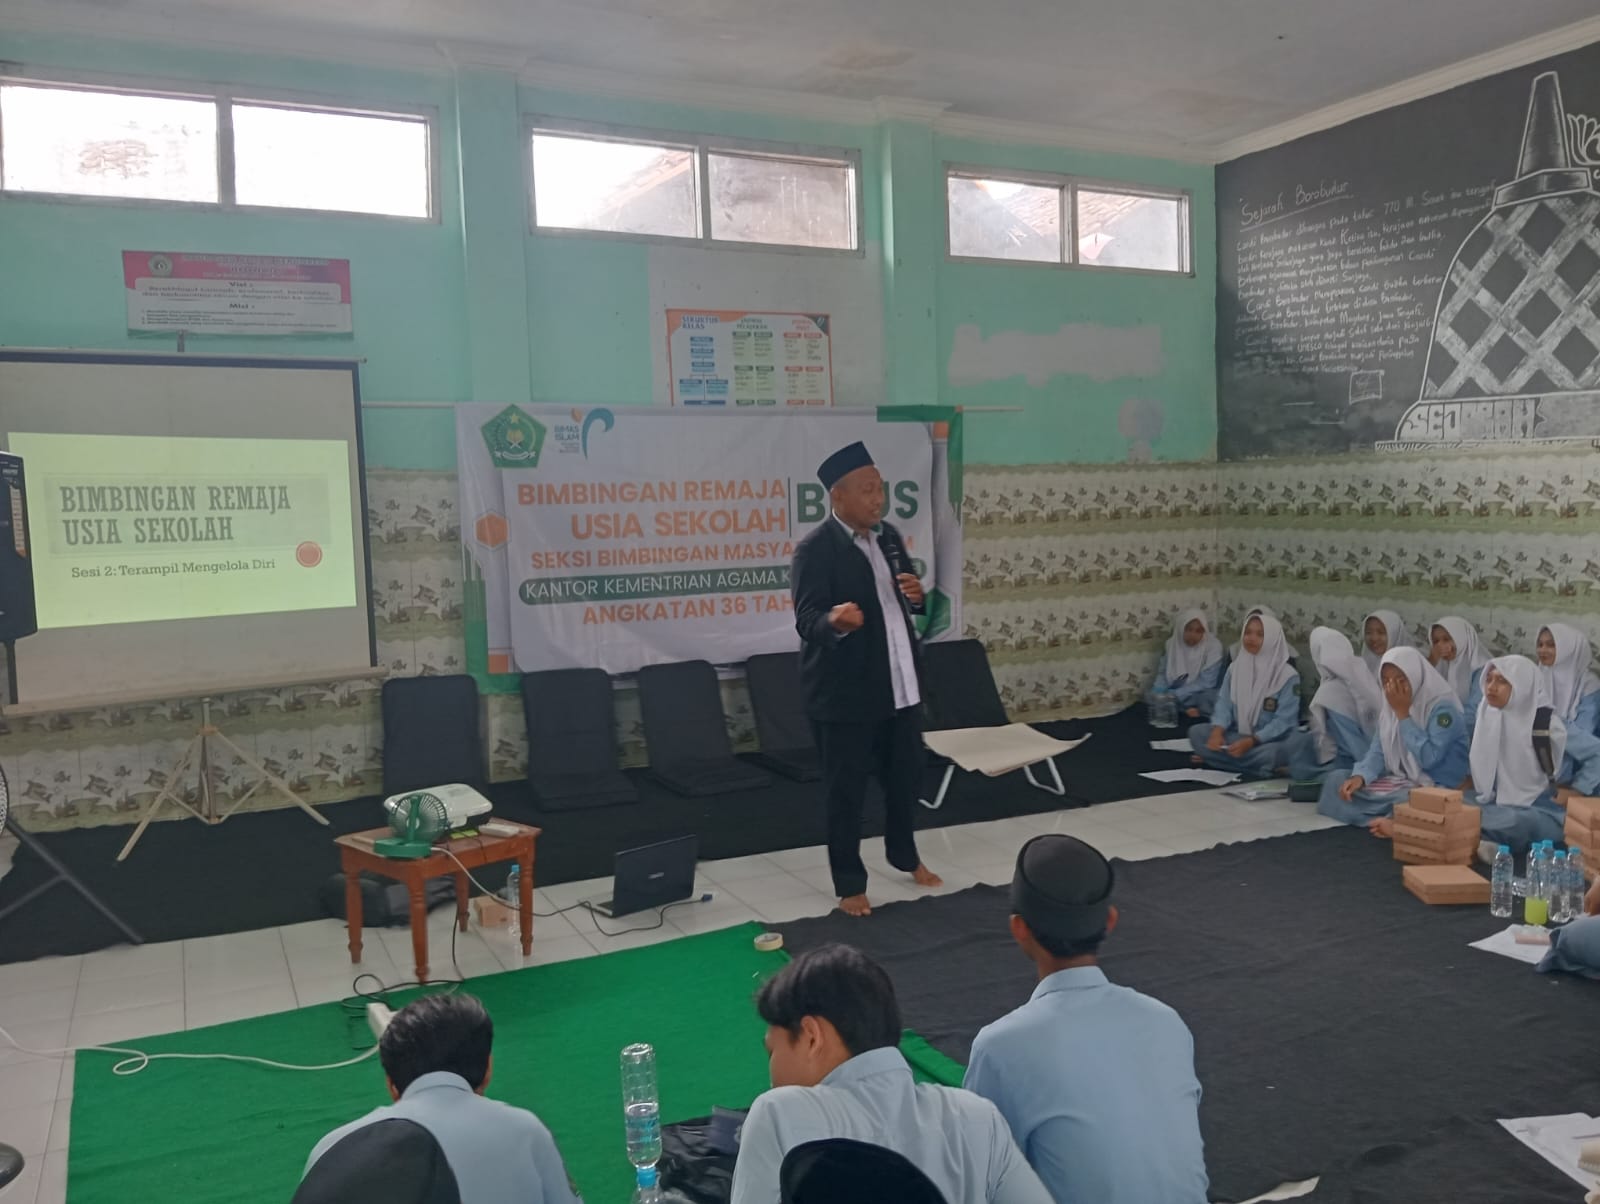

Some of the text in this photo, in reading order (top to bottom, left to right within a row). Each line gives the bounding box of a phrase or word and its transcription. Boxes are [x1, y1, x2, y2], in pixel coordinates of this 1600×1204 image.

[59, 485, 292, 515] BIMBINGAN REMAJA
[517, 479, 786, 505] BIMBINGAN REMAJA
[62, 516, 235, 546] USIA SEKOLAH
[571, 507, 787, 540] USIA SEKOLAH
[71, 566, 100, 578] Sesi
[118, 561, 179, 577] Terampil
[182, 559, 249, 574] Mengelola
[252, 558, 276, 569] Diri
[531, 541, 795, 569] SEKSI BIMBINGAN MASYA
[526, 580, 599, 598] KANTOR
[604, 574, 712, 595] KEMENTRIAN
[716, 569, 778, 588] AGAMA
[583, 594, 796, 624] ANGKATAN 36 TAH
